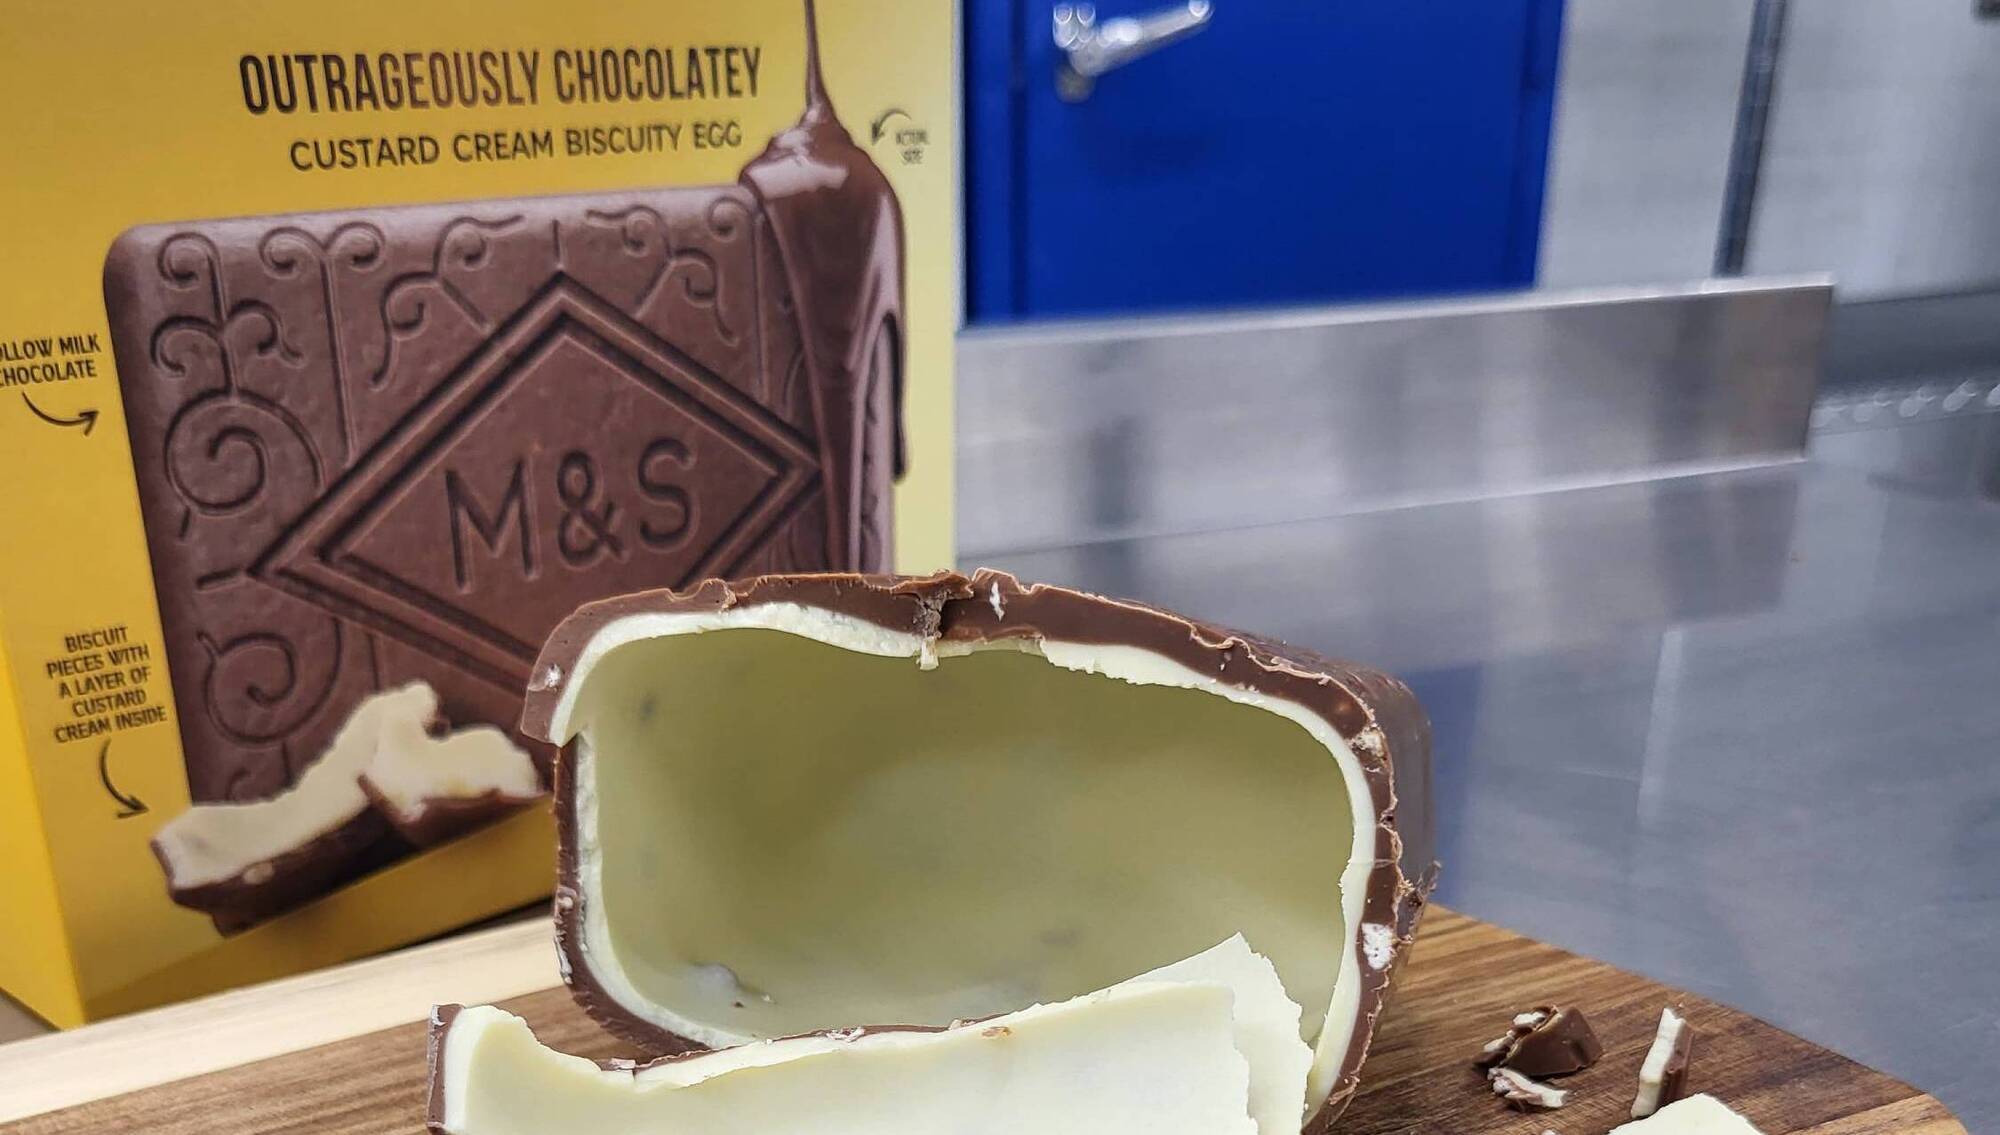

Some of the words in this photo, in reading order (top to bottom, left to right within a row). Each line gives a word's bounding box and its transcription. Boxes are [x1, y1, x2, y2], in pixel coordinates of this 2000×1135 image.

[239, 50, 540, 115] OUTRAGEOUSLY
[553, 46, 761, 105] CHOCOLATEY
[290, 136, 440, 171] CUSTARD
[453, 129, 554, 162] CREAM
[565, 123, 682, 156] BISCUITY
[693, 121, 742, 150] EGG
[0, 338, 53, 361] LLOW
[59, 333, 101, 355] MILK
[445, 436, 697, 594] M&S
[65, 626, 128, 653] BISCUIT
[46, 654, 104, 679] PIECES
[106, 643, 150, 667] WITH
[59, 681, 72, 699] A
[75, 671, 126, 696] LAYER
[130, 666, 151, 684] OF
[72, 689, 147, 718] CUSTARD
[54, 718, 112, 743] CREAM
[115, 705, 167, 730] INSIDE
